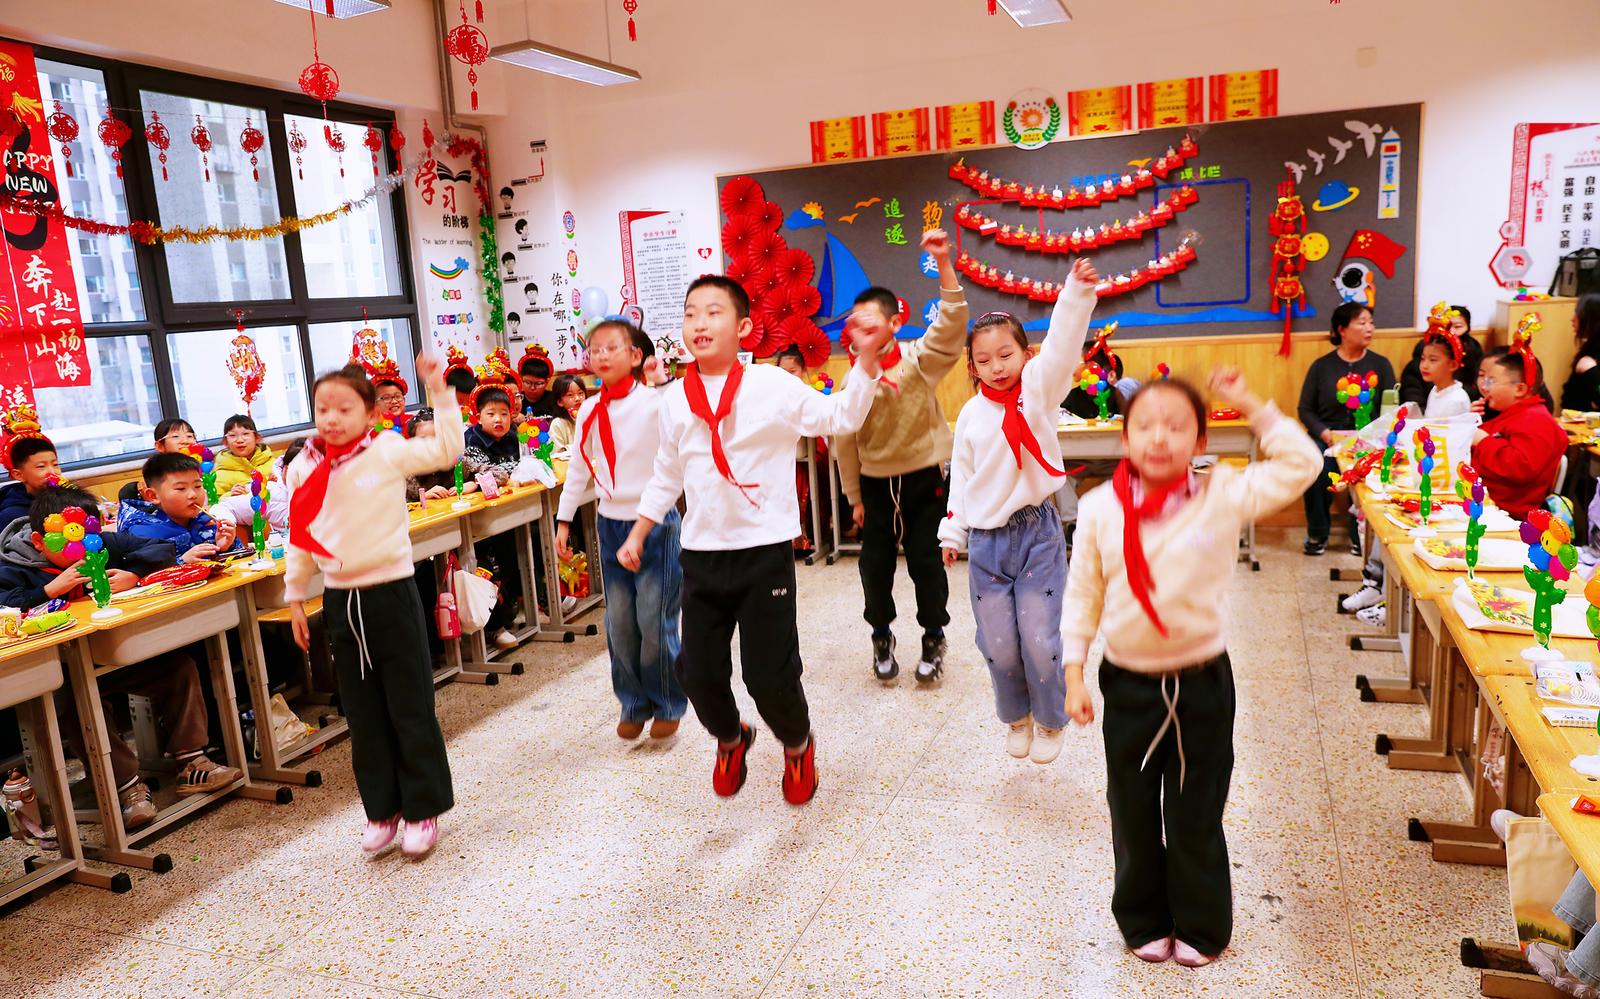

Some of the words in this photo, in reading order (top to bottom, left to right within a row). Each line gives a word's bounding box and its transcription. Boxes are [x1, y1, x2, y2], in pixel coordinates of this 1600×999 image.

[5, 173, 48, 193] NEW
[415, 159, 457, 214] 学习
[1563, 177, 1575, 197] 富强
[1584, 176, 1596, 196] 自由
[442, 213, 469, 229] 的阶梯
[884, 197, 908, 245] 追逐
[1562, 203, 1574, 223] 民主
[1583, 202, 1593, 222] 平等
[1560, 230, 1571, 249] 文明
